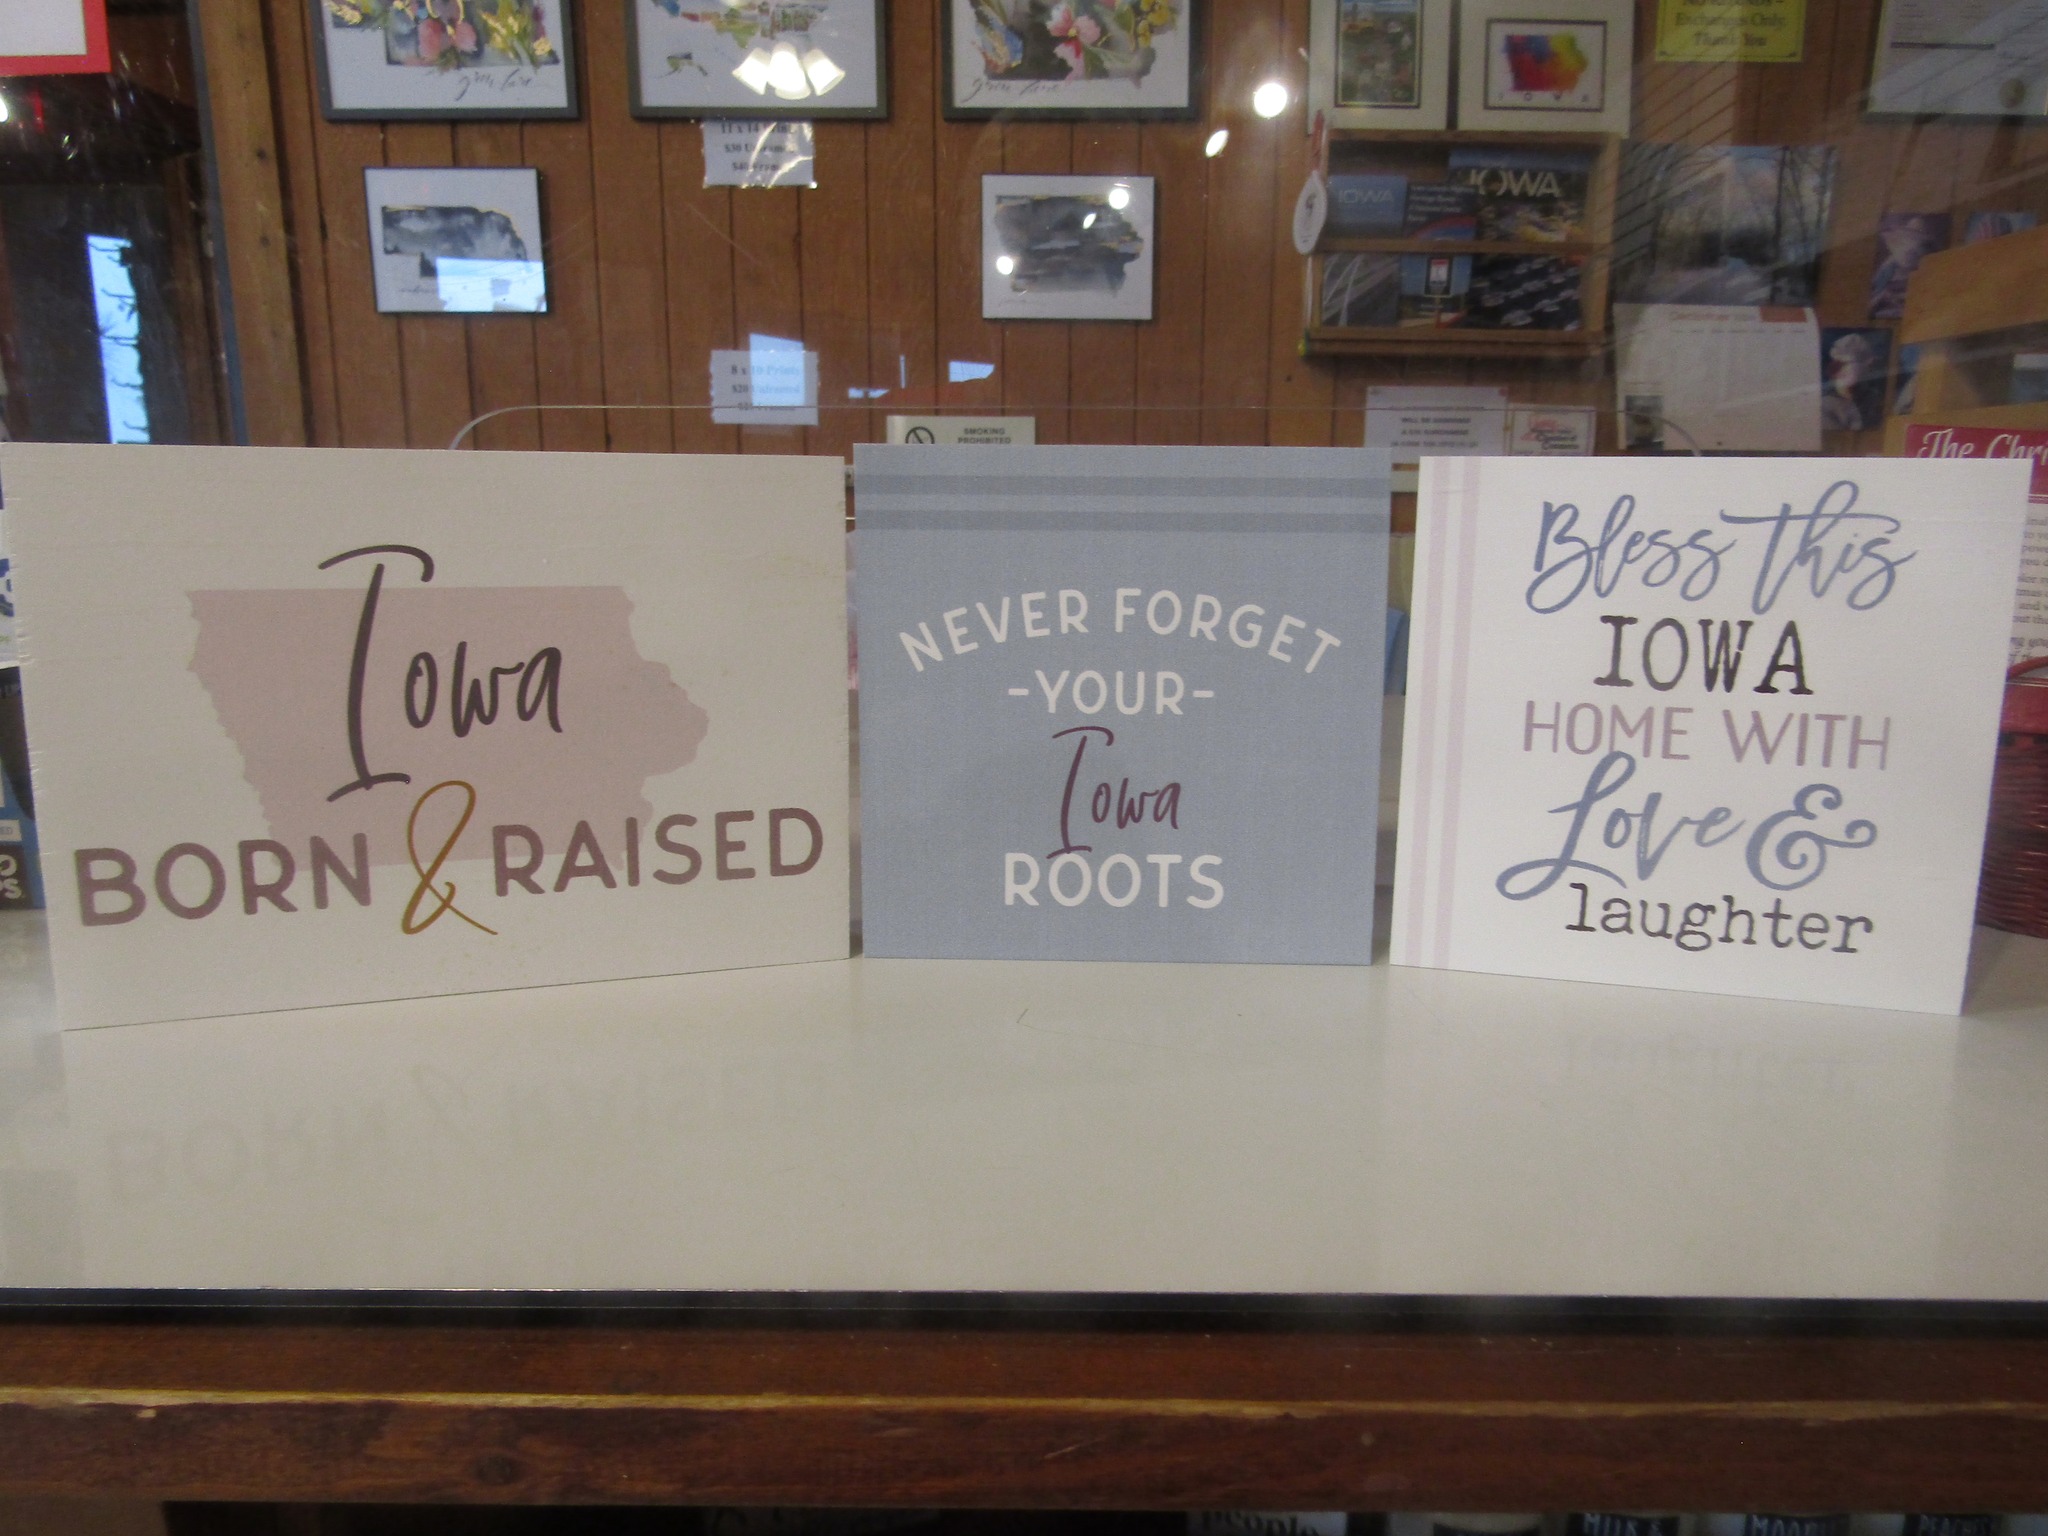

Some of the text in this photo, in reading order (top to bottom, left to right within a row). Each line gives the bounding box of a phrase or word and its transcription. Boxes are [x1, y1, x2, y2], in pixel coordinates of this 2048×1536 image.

[1468, 168, 1564, 198] IOWA
[963, 427, 1006, 435] SMOKING
[1917, 428, 1975, 459] The
[1525, 480, 1919, 616] Bless this
[900, 587, 1342, 674] NEVER FORGET
[1593, 614, 1814, 696] IOWA
[318, 544, 563, 802] Iowa
[1523, 700, 1892, 771] HOME WITH
[1046, 725, 1182, 859] Iowa
[1496, 750, 1879, 901] Love &
[73, 779, 824, 936] BORN & RAISED
[1004, 851, 1225, 909] ROOTS
[1565, 882, 1874, 954] laughter
